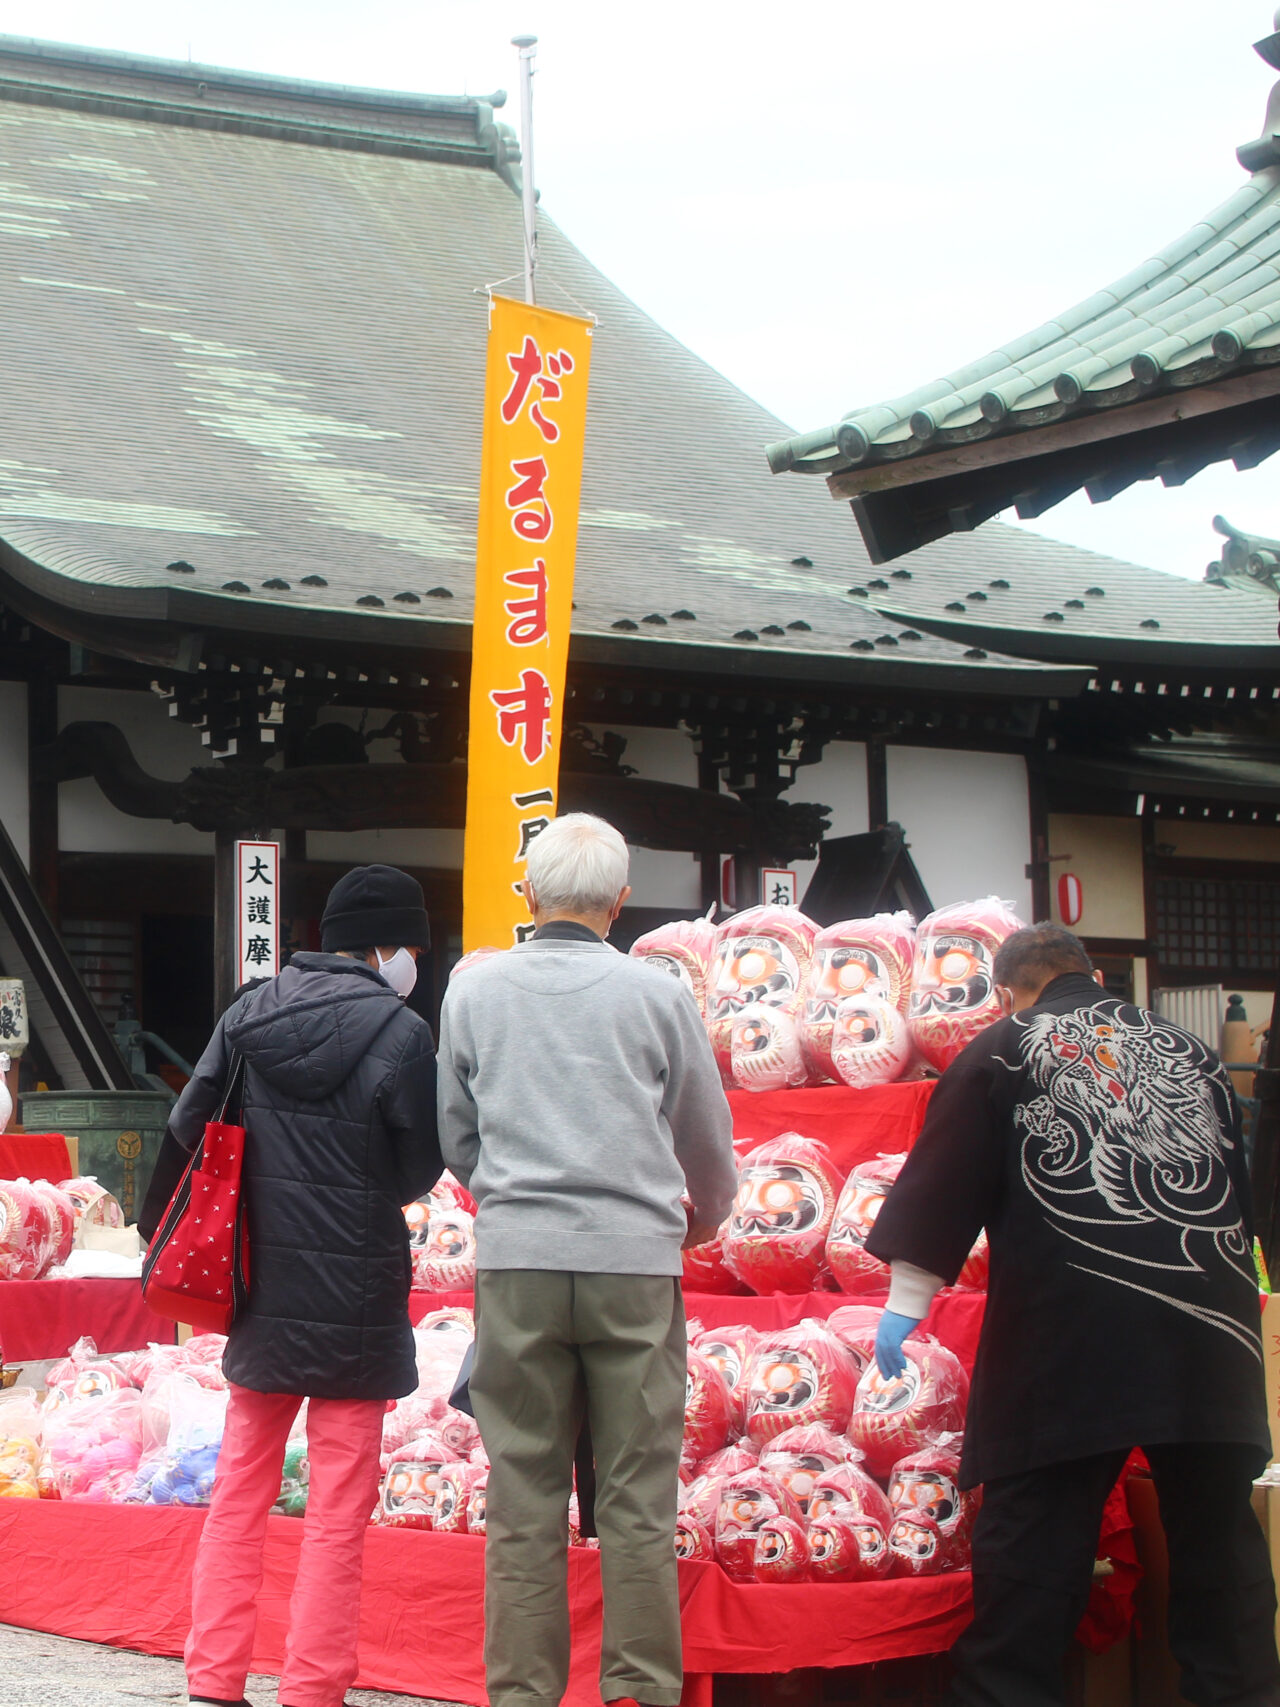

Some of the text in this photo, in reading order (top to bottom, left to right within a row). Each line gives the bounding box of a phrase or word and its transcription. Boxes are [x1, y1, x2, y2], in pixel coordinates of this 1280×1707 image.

[486, 335, 575, 767] だるま市
[244, 855, 273, 981] 大護摩
